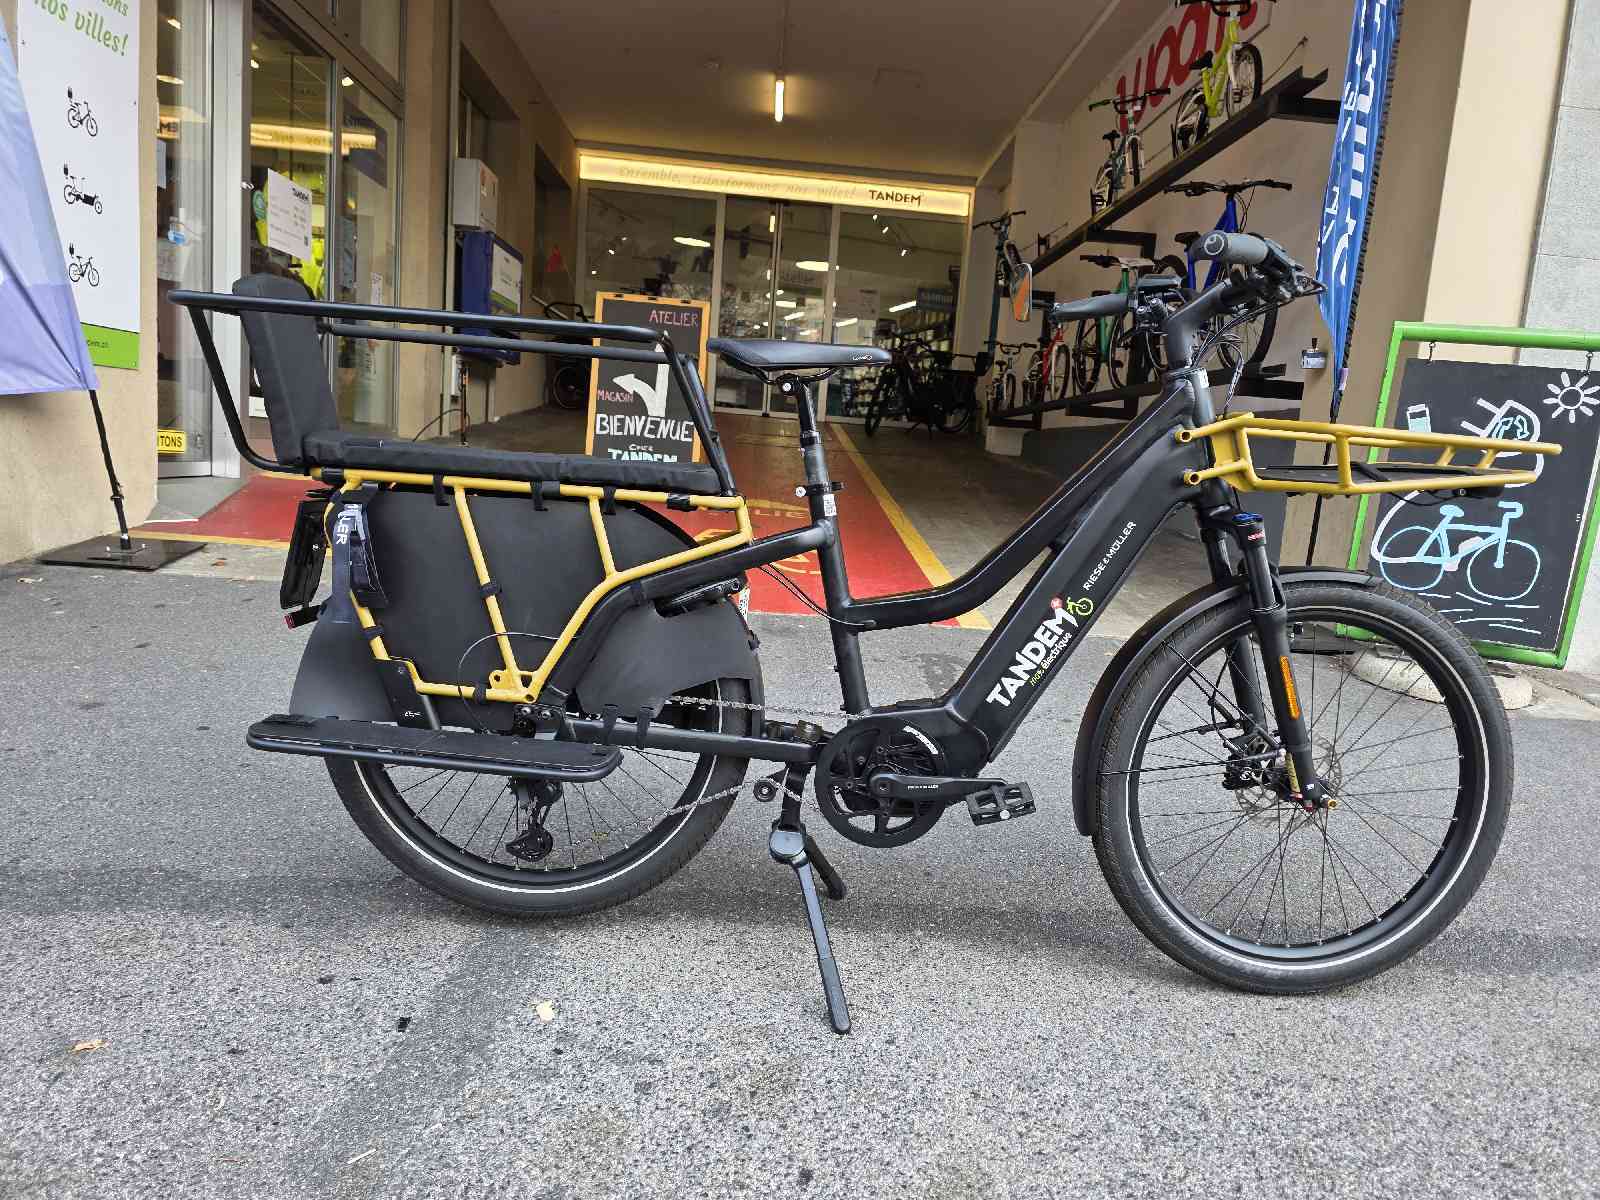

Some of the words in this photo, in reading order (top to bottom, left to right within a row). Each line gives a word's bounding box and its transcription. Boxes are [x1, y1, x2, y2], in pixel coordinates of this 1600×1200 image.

[74, 11, 128, 56] villes!
[869, 189, 921, 206] TANDEM
[649, 310, 698, 327] ATELIER
[597, 388, 634, 403] MAGASIN
[596, 413, 694, 442] BIENVENUE
[607, 448, 678, 463] TANDEM
[985, 607, 1079, 707] TANDEM
